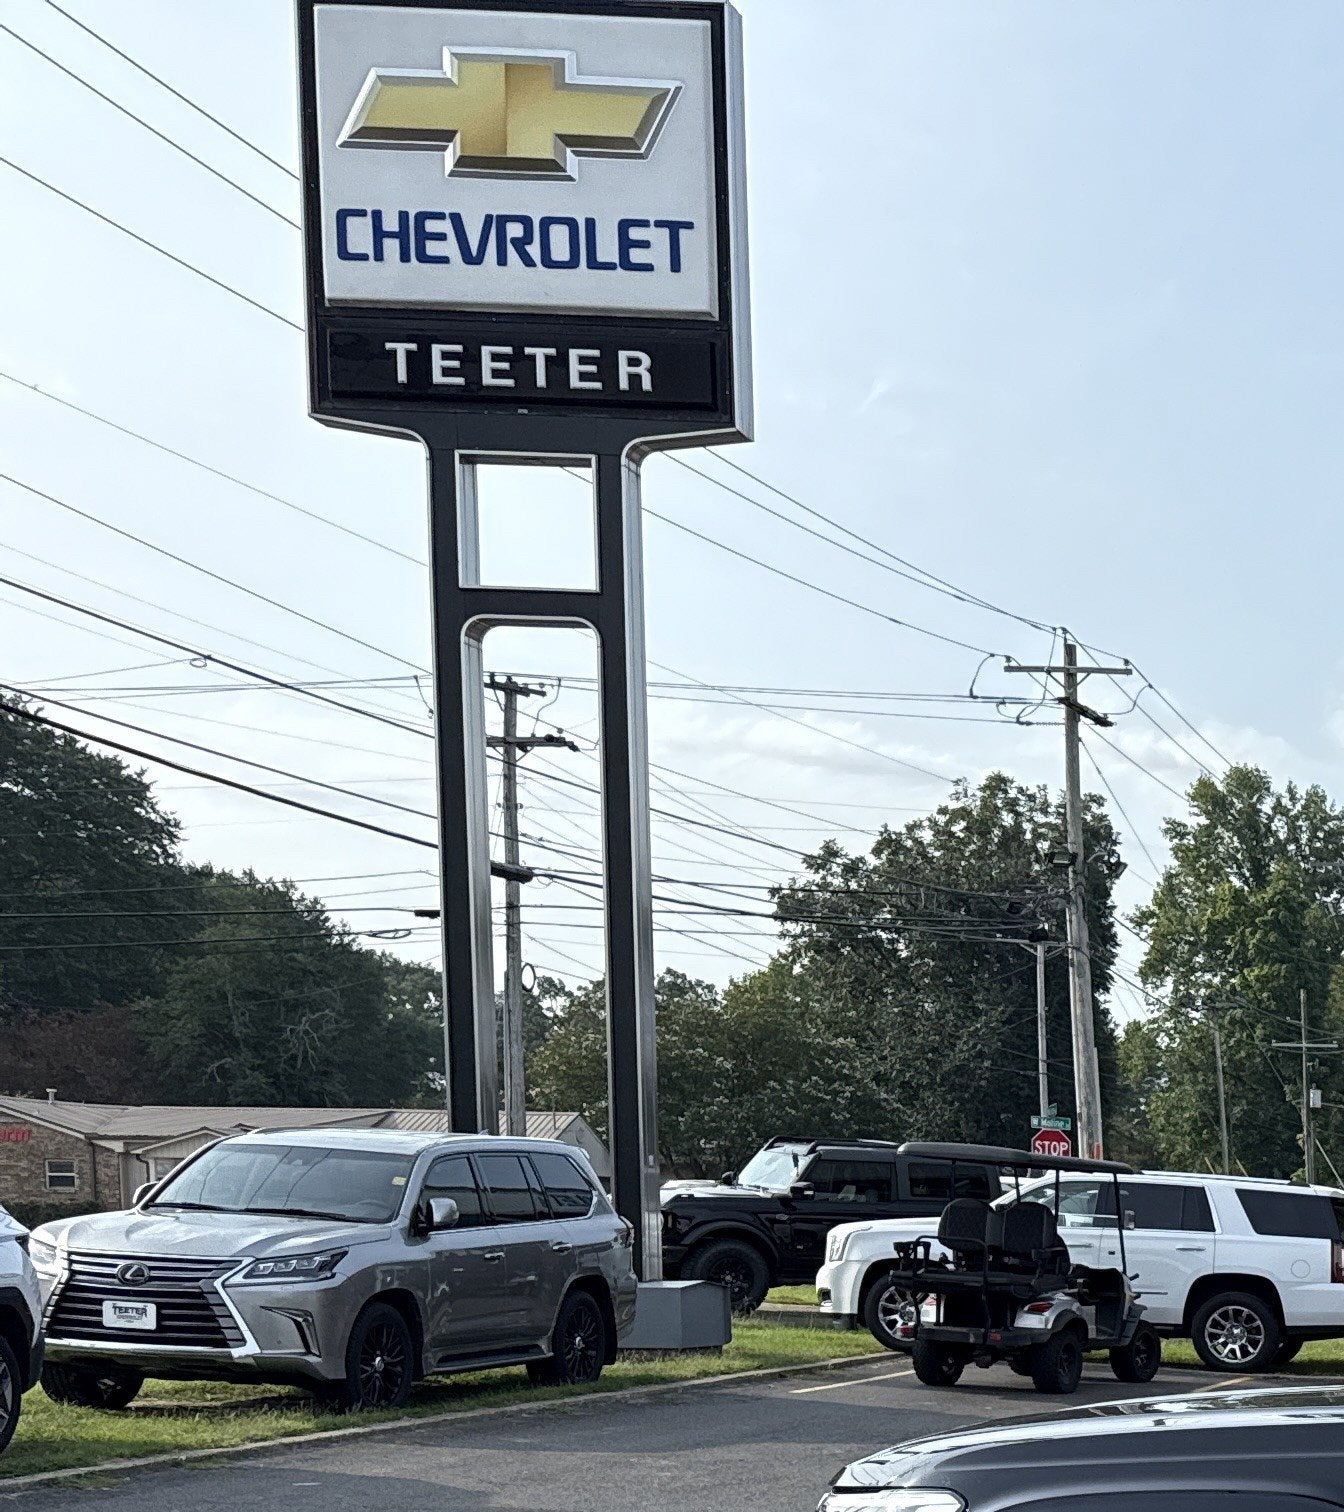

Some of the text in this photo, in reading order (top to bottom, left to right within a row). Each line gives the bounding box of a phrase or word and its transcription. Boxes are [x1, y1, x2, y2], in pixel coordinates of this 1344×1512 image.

[336, 208, 694, 273] CHEVROLET
[385, 342, 653, 392] TEETER
[1035, 1141, 1069, 1156] STOP
